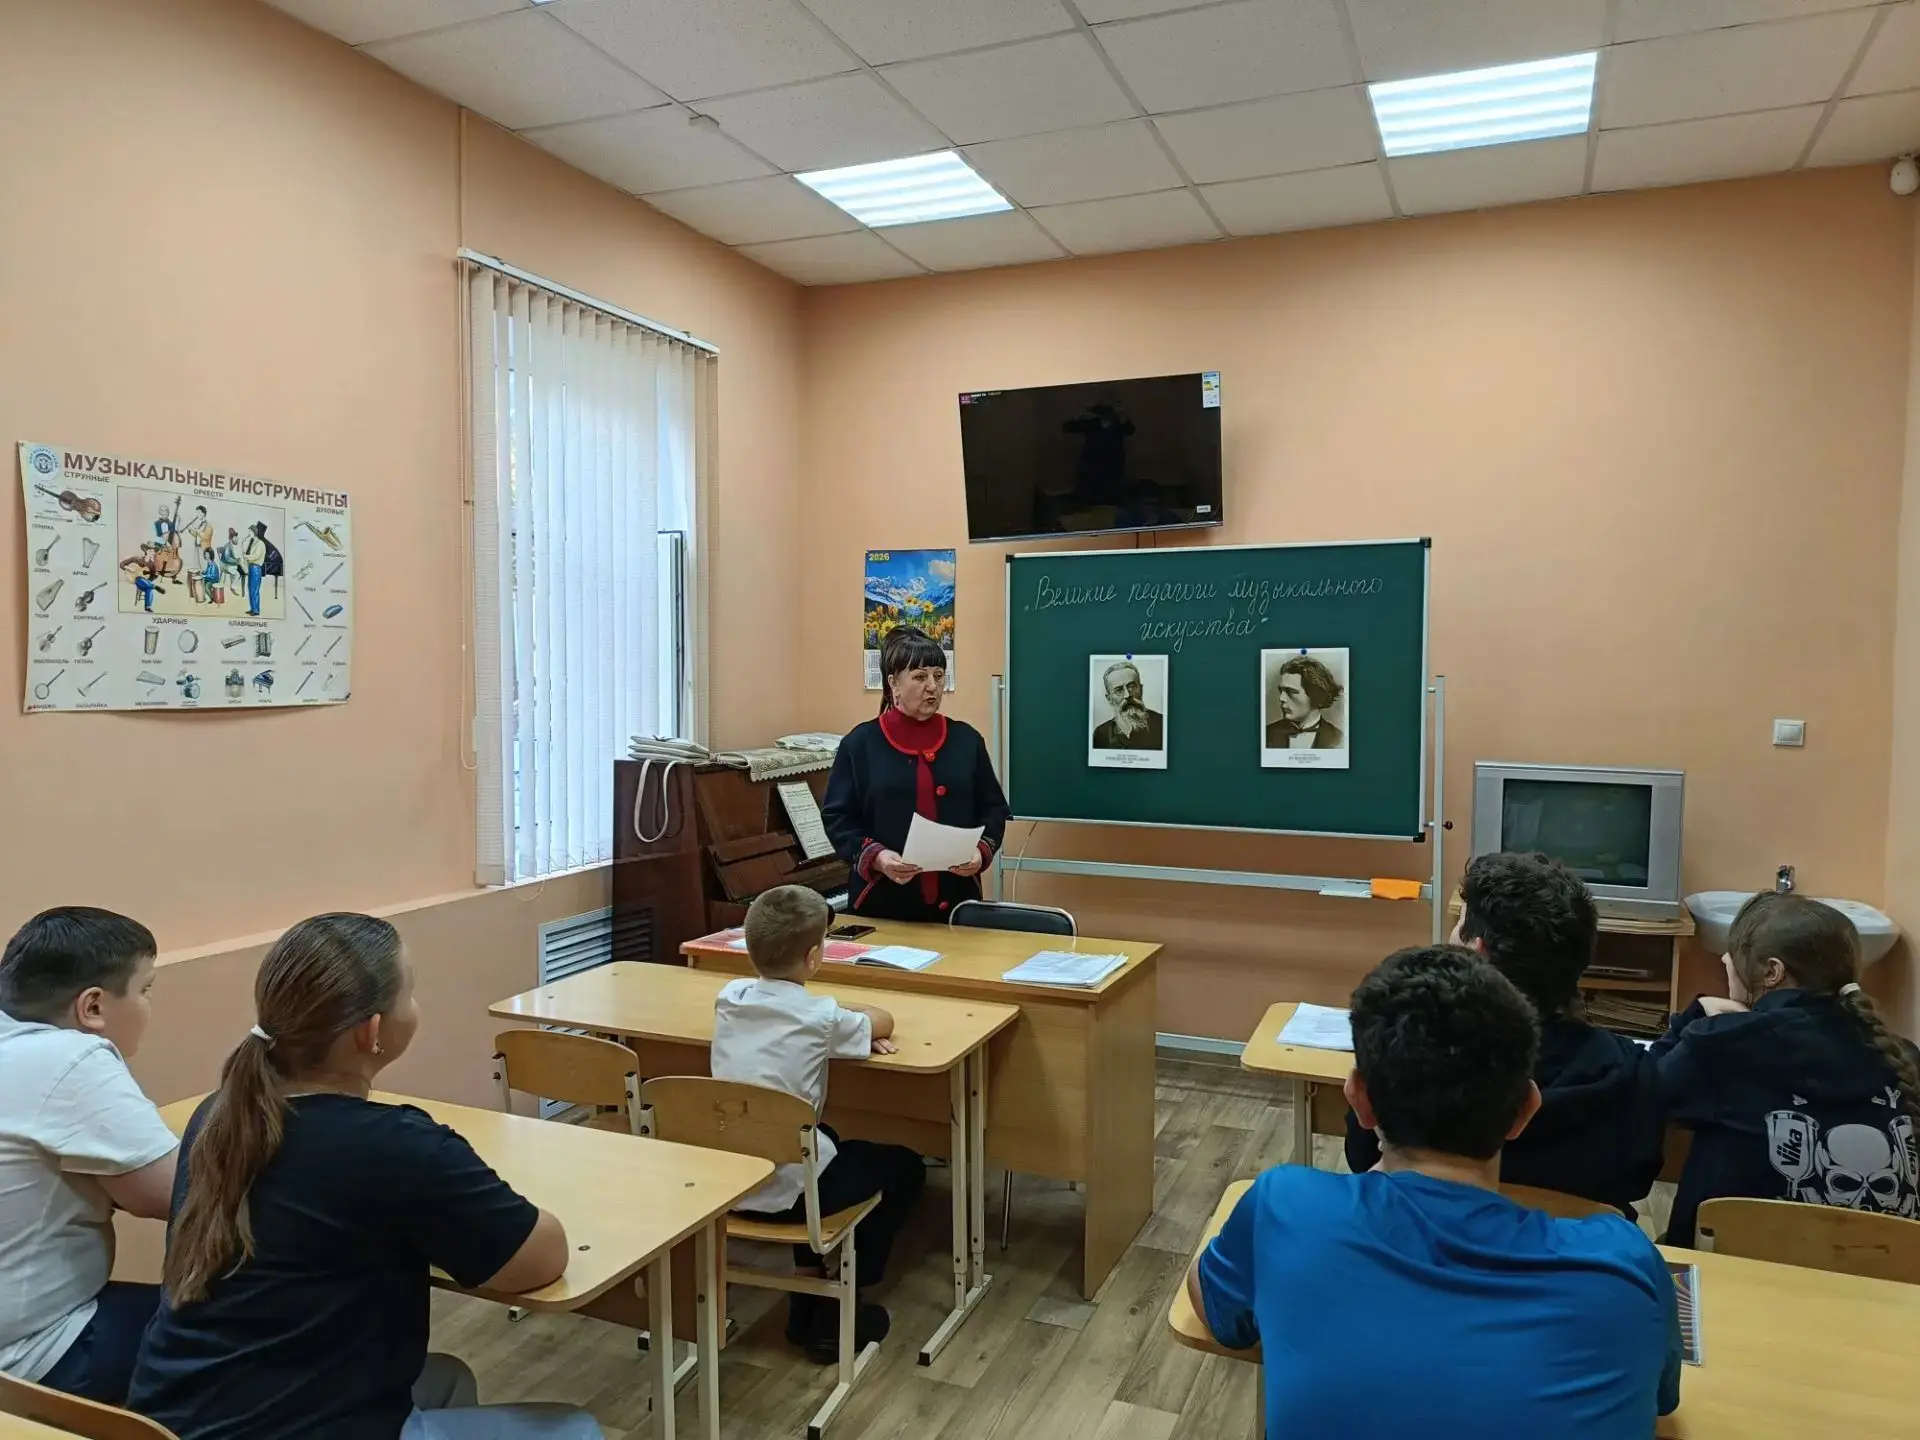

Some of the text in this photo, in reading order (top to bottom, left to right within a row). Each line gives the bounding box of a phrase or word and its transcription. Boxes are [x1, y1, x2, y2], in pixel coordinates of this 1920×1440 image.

[64, 471, 110, 483] СТРУННЫЕ
[64, 452, 225, 490] МУЗЫКАЛЬНЫЕ
[229, 476, 348, 508] ИНСТРУМЕНТЫ
[193, 488, 224, 498] ОРКЕСТР
[315, 506, 345, 516] ДУХОВЫЕ
[868, 552, 890, 561] 2026
[1127, 580, 1217, 617] педагоги
[1227, 577, 1384, 616] музыкального
[152, 617, 188, 626] УДАРНЫЕ
[228, 620, 268, 629] КЛАВИШНЫЕ
